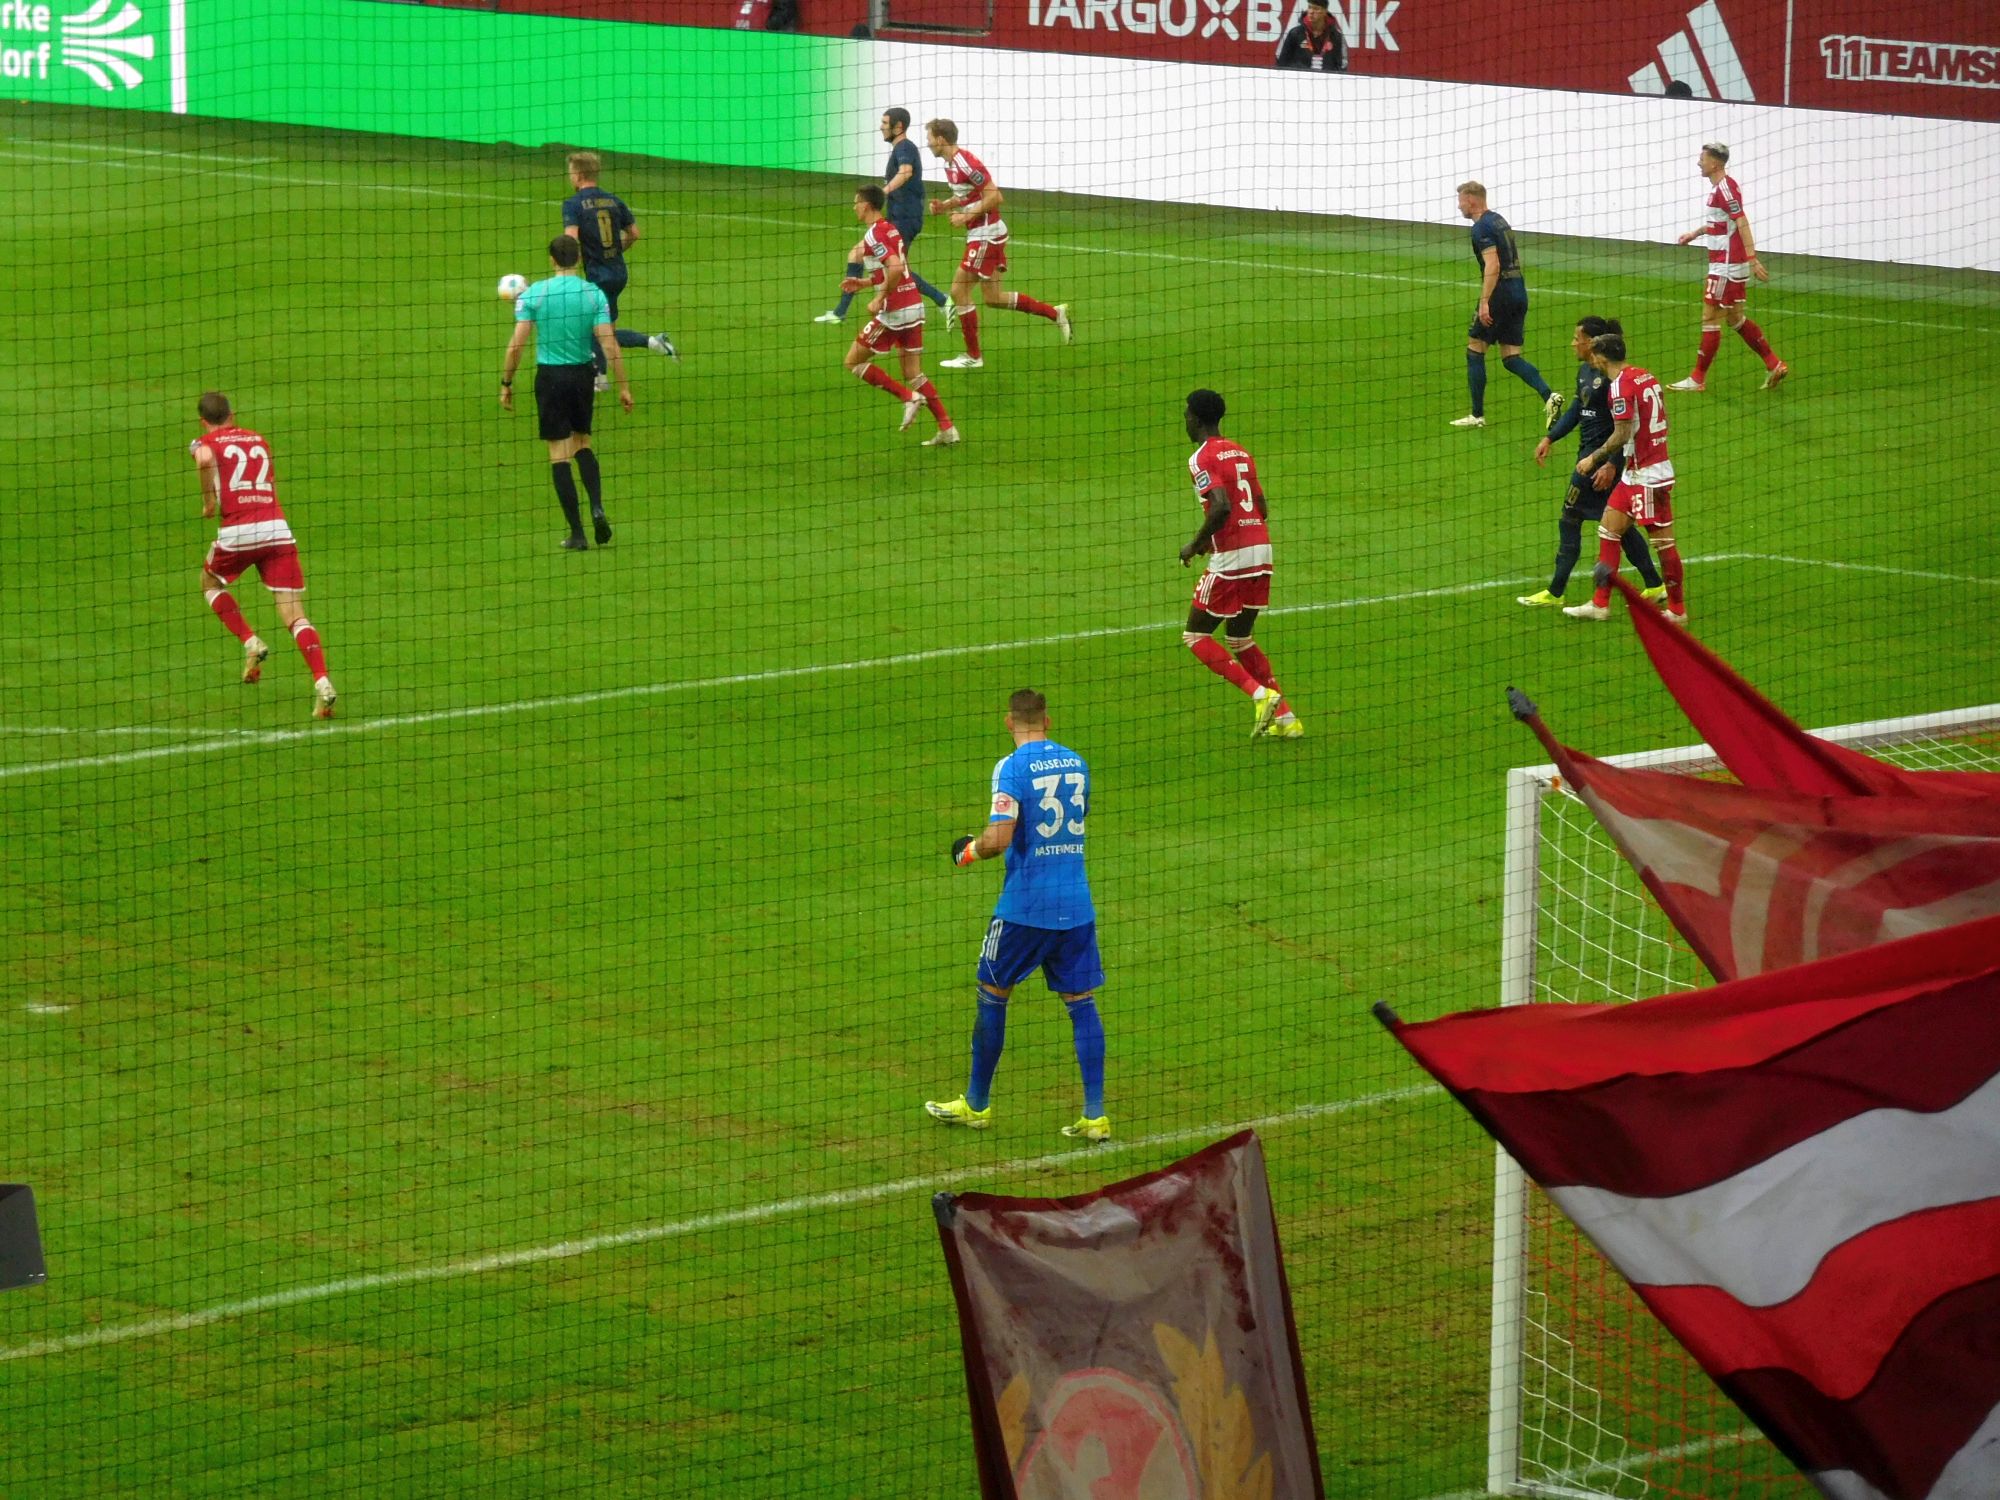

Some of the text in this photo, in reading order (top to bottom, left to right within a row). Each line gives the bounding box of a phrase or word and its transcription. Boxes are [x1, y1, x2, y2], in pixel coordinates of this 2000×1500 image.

[1819, 33, 2000, 89] 11TEAMS
[223, 444, 273, 492] 22
[1235, 463, 1254, 512] 5
[1032, 772, 1086, 838] 33
